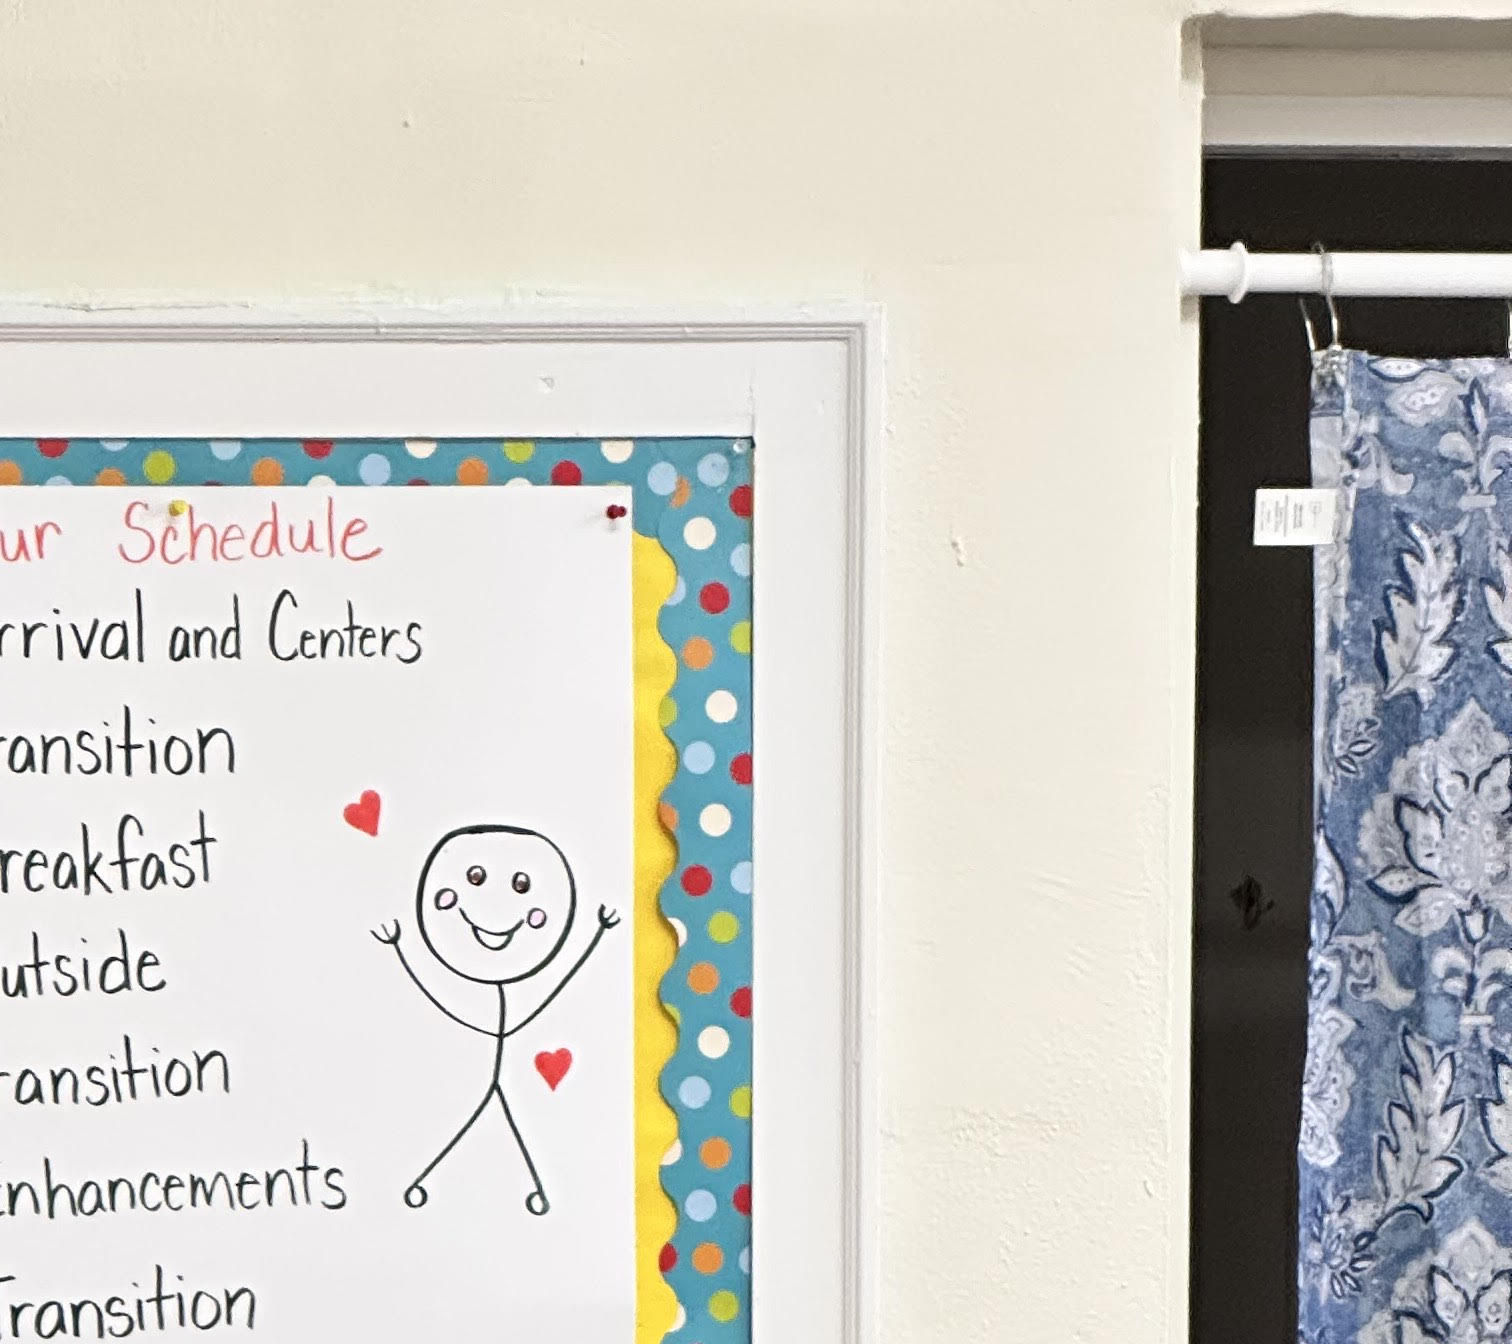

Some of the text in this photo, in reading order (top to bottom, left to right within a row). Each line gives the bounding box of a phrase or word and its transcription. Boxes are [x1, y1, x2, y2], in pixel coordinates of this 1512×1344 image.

[119, 499, 382, 564] Schedule
[169, 593, 242, 663] and
[268, 588, 423, 664] Centers
